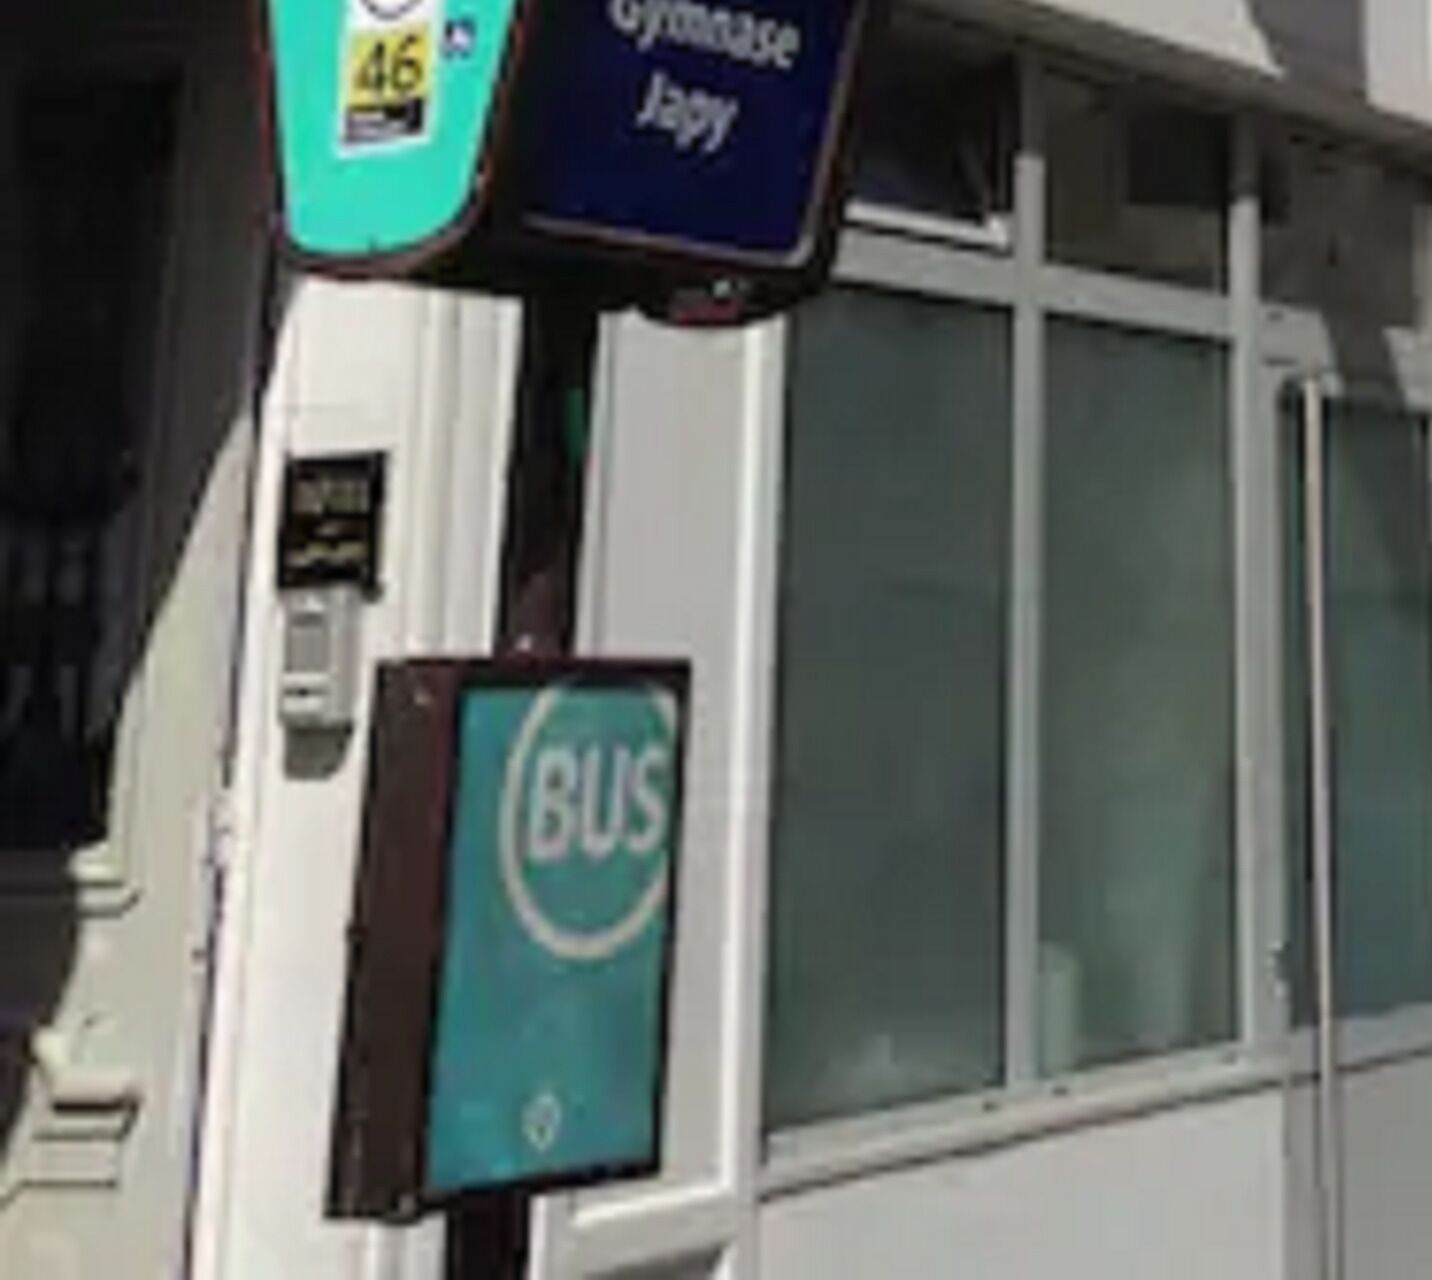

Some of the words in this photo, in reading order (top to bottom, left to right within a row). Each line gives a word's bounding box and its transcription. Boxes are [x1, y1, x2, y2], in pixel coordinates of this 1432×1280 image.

[352, 33, 426, 95] 46
[636, 72, 739, 153] Japy
[530, 743, 669, 861] BUS
